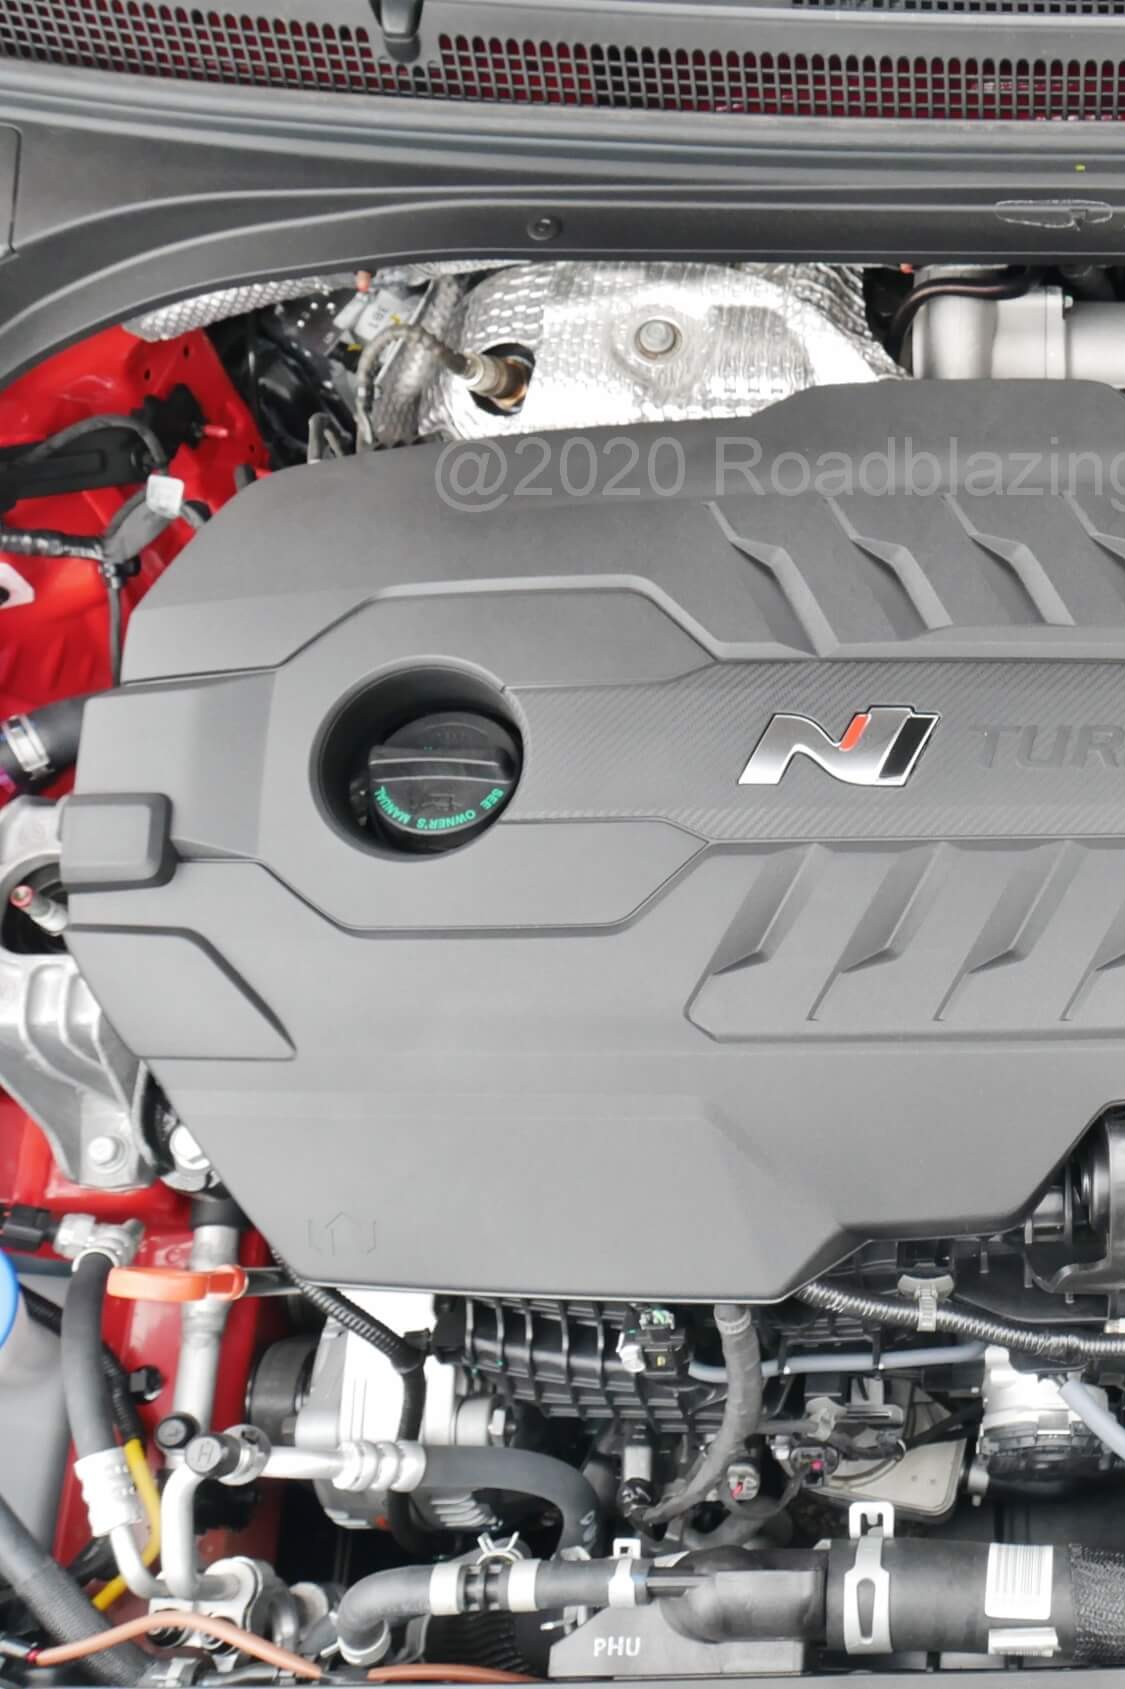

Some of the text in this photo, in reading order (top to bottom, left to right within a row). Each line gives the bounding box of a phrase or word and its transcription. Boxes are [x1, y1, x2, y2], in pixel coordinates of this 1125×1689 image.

[374, 786, 504, 830] SEE OWNER'S MANUAL
[593, 1636, 641, 1657] PHU
